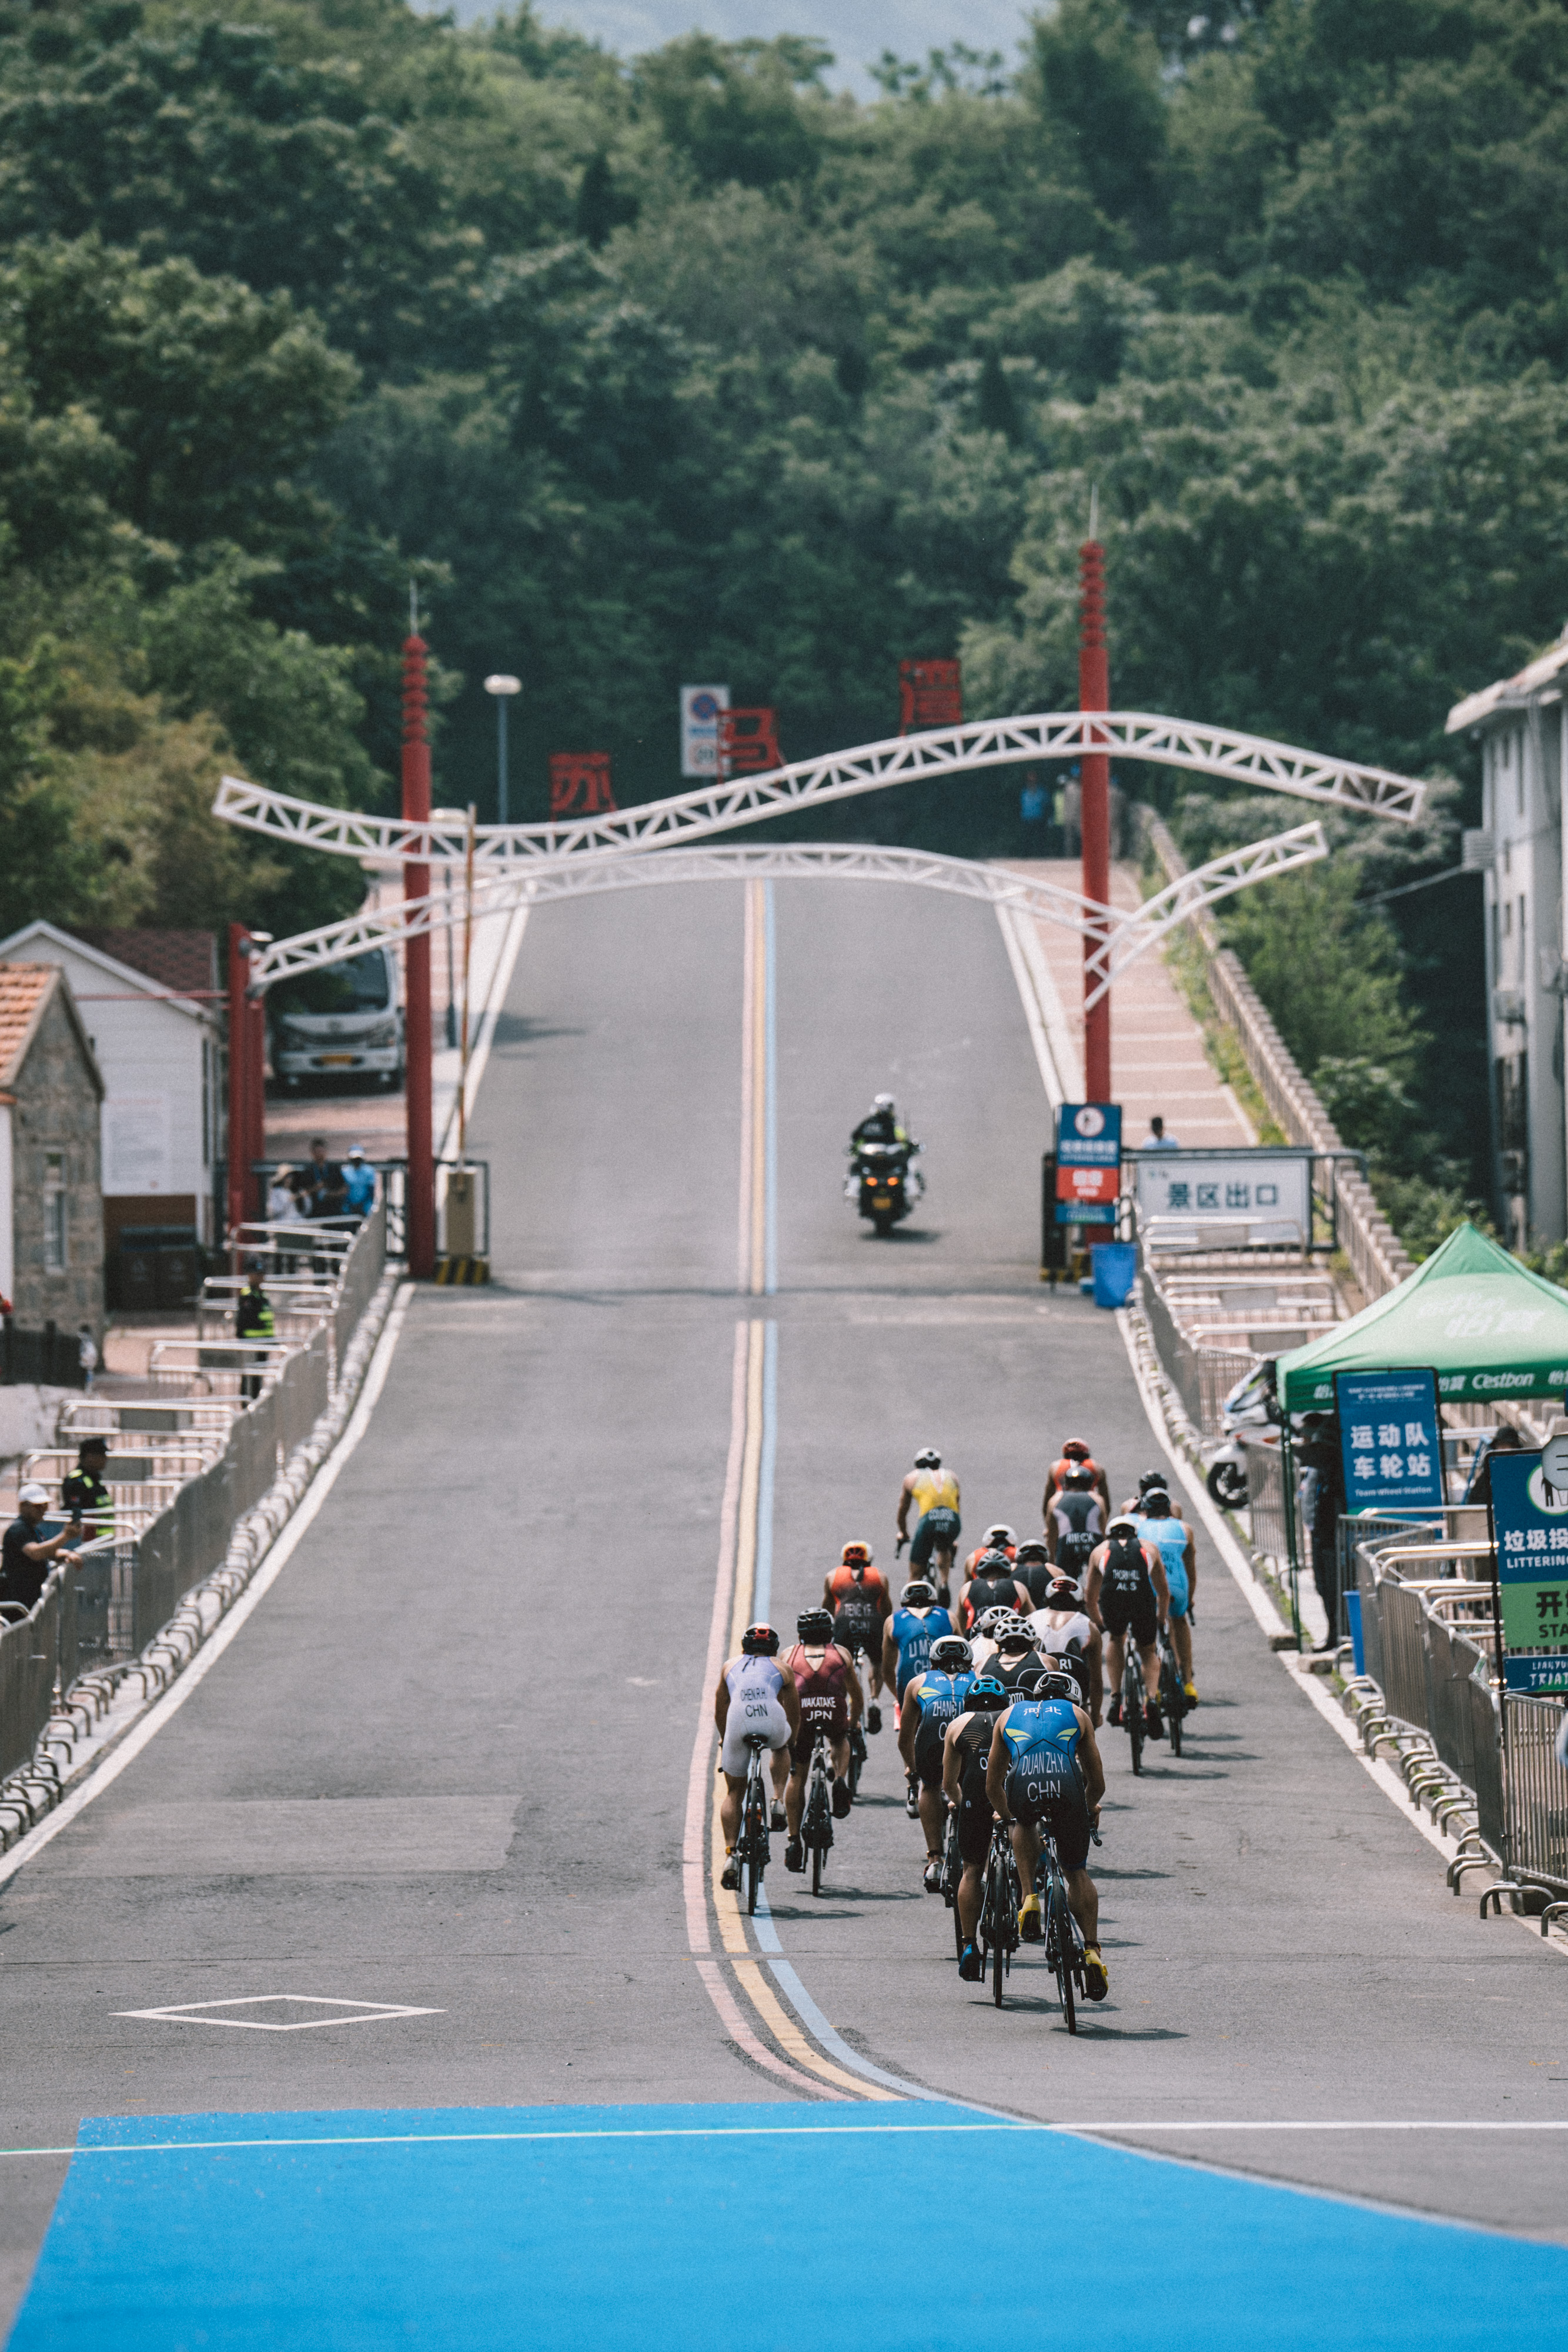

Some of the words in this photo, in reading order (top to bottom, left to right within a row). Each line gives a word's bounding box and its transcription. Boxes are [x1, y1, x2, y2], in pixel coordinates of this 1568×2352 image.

[1169, 1183, 1277, 1209] 景区出口
[1350, 1422, 1430, 1449] 运动队
[1353, 1453, 1431, 1480] 车轮站
[1355, 1488, 1376, 1497] Team
[1377, 1488, 1402, 1496] Wheel
[1403, 1486, 1433, 1495] Station
[1504, 1528, 1568, 1552] 垃圾投
[1507, 1555, 1568, 1569] LITTERIN
[745, 1703, 768, 1717] CHN
[801, 1696, 836, 1708] WAKATAKE
[1024, 1706, 1062, 1716] 河北
[806, 1710, 833, 1721] JPN
[1022, 1752, 1044, 1776] DUAN
[1046, 1752, 1066, 1773] ZH.Y.
[1027, 1780, 1061, 1802] CHN
